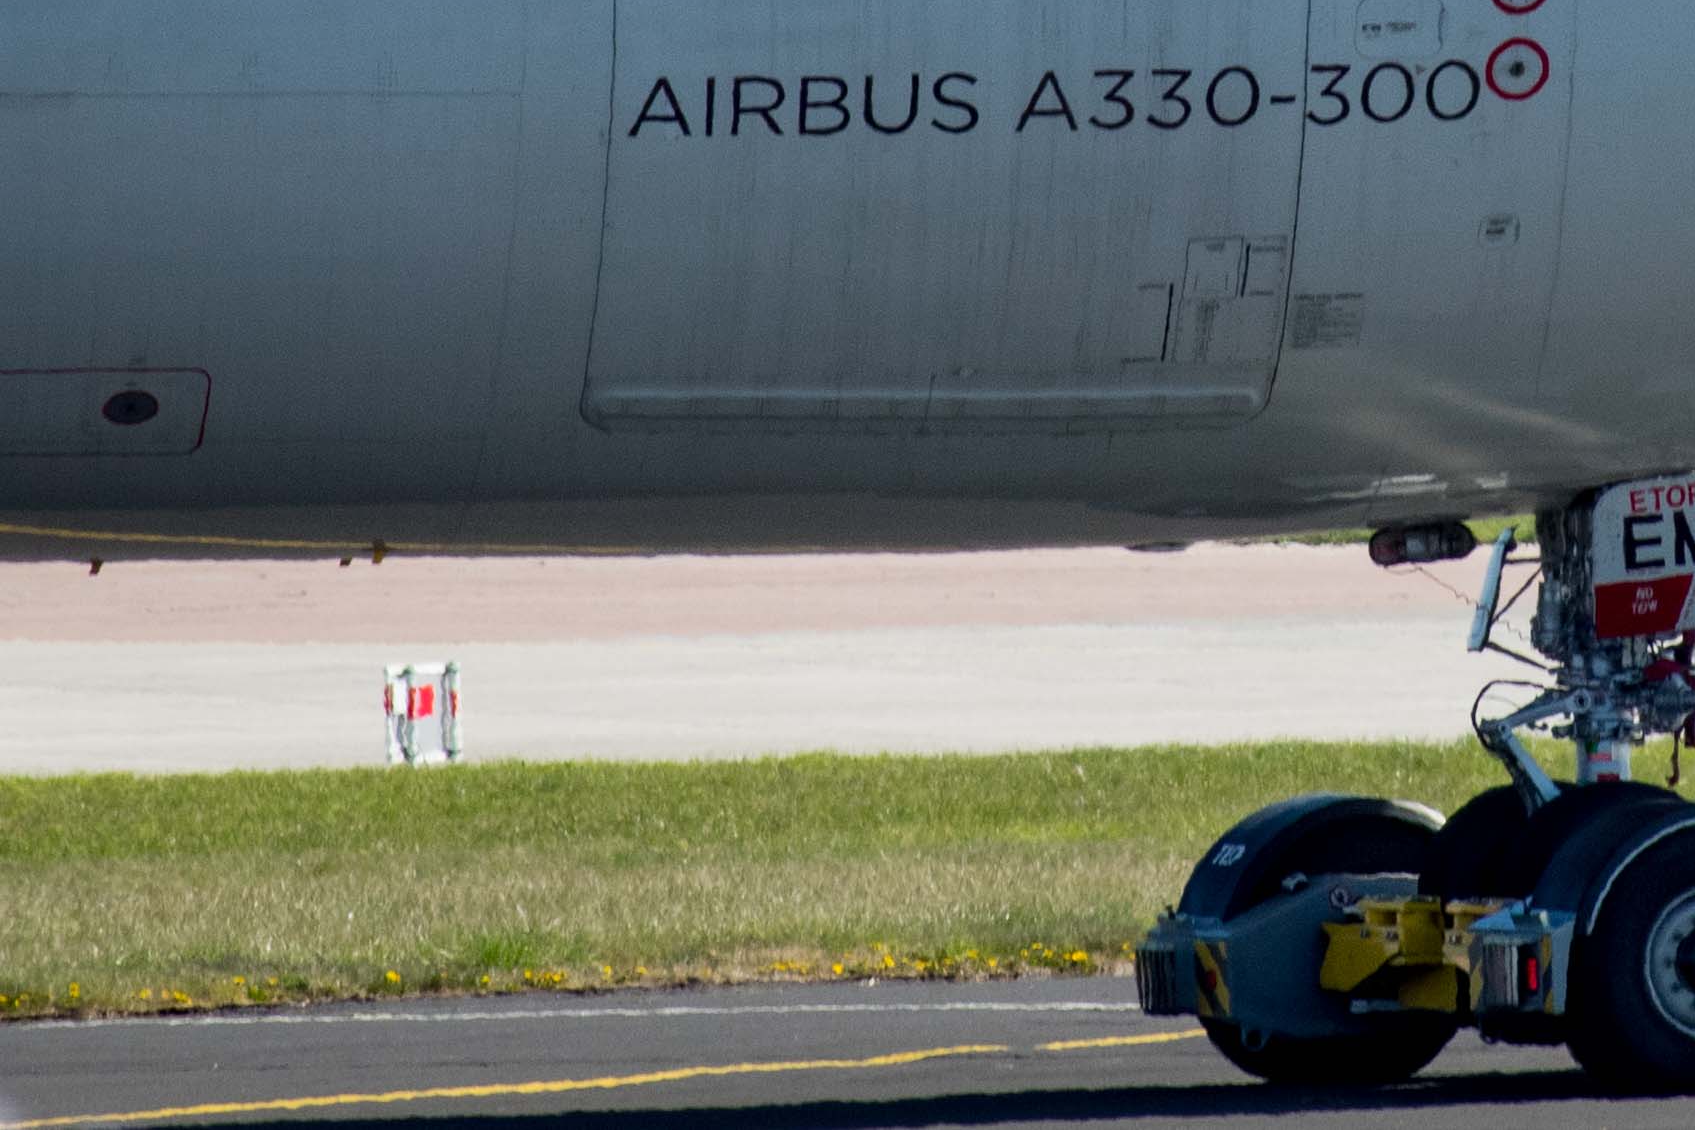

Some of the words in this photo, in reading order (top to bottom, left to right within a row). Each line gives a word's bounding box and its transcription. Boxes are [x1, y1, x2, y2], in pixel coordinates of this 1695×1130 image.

[628, 72, 979, 136] AIRBUS
[1015, 60, 1481, 133] A330-300
[1636, 587, 1654, 599] NO
